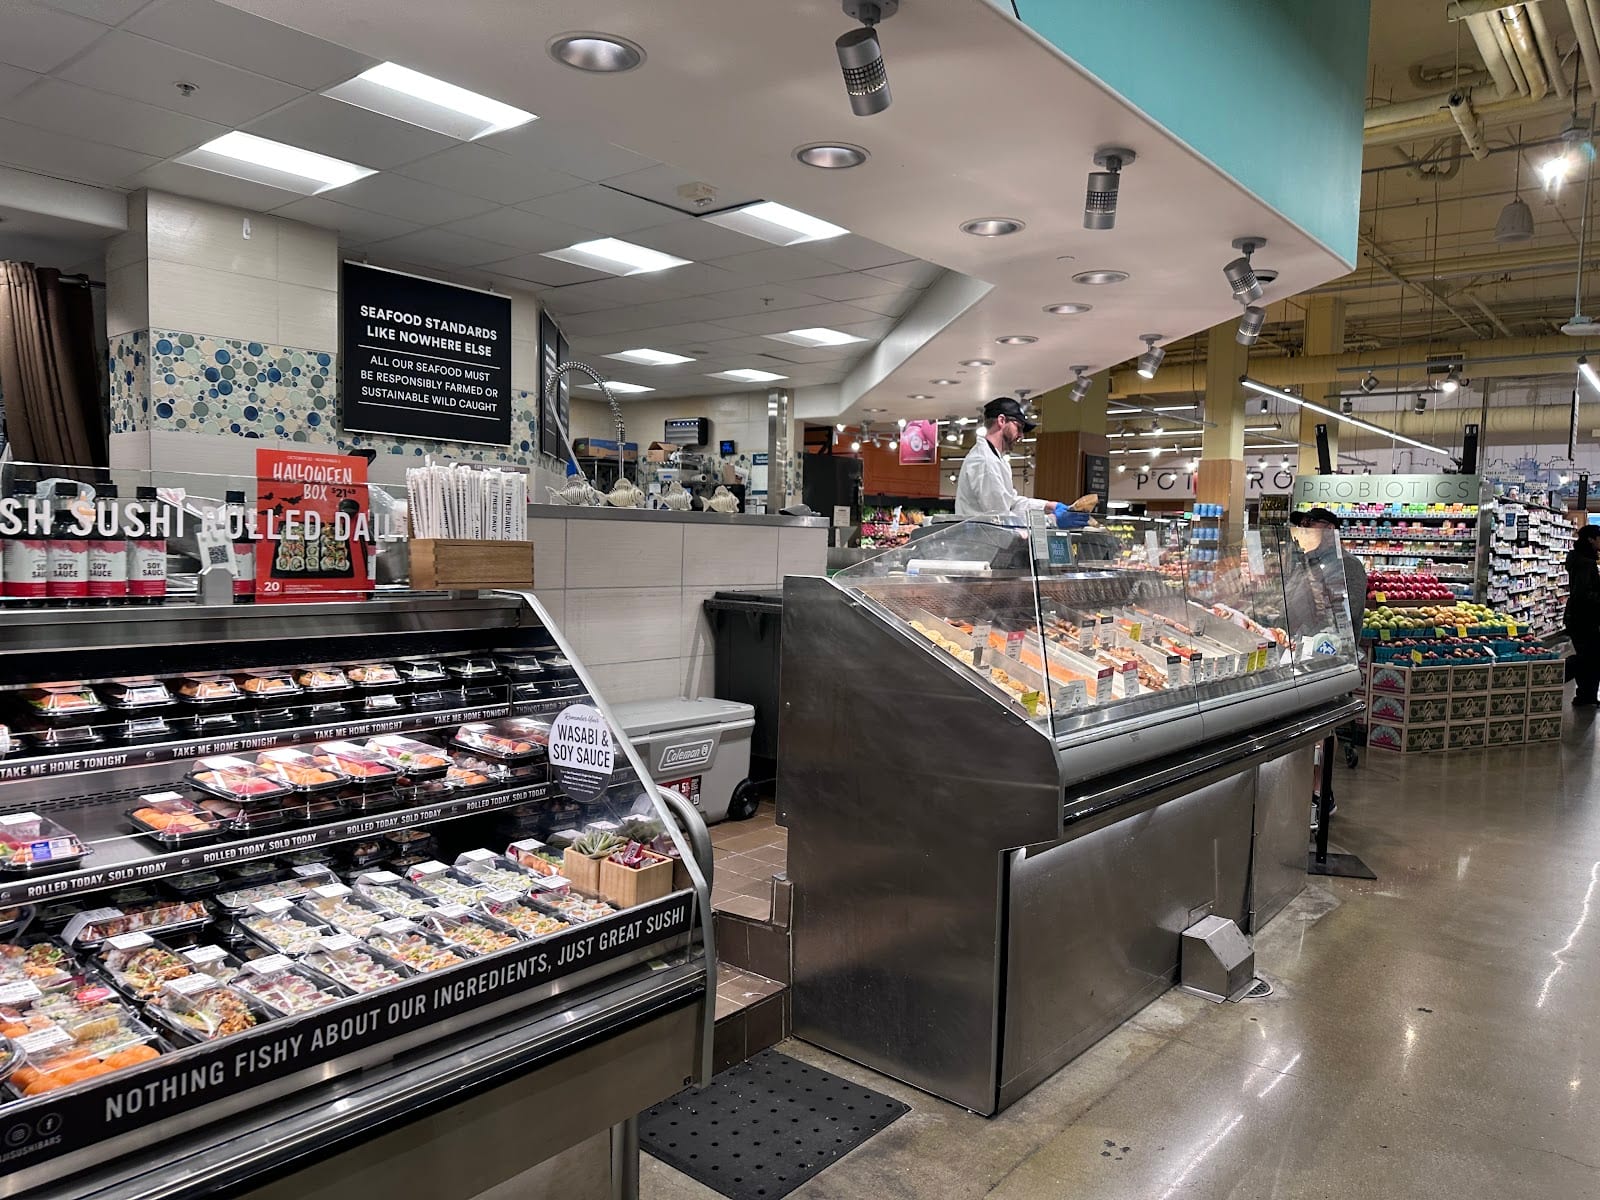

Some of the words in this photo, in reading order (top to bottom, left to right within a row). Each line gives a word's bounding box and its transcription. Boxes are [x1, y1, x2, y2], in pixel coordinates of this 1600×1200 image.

[360, 305, 422, 327] SEAFOOD
[425, 317, 498, 341] STANDARDS
[366, 325, 396, 341] LIKE
[399, 330, 462, 352] NOWHERE
[464, 343, 492, 357] ELSE
[370, 355, 390, 367] ALL
[391, 358, 414, 370] OUR
[416, 361, 462, 378] SEAFOOD
[464, 369, 490, 382] MUST
[360, 370, 374, 381] BE
[376, 371, 443, 390] RESPONSIBLY
[444, 382, 483, 396] FARMED
[484, 388, 499, 399] OR
[361, 386, 430, 404] SUSTAINABLE
[431, 396, 457, 408] WILD
[458, 399, 498, 413] CAUGHT
[273, 462, 352, 485] HALLOWEEN
[1137, 471, 1293, 490] POTRO
[304, 484, 328, 500] BOX
[1302, 481, 1470, 498] PROBIOTICS
[70, 501, 184, 538] SUSHI
[202, 506, 321, 541] ROLLED
[93, 562, 107, 570] SOY
[264, 581, 280, 592] 20
[434, 714, 450, 724] TAKE
[452, 713, 462, 722] ME
[463, 710, 481, 720] HOME
[483, 707, 510, 719] TONIGHT
[314, 729, 334, 739] TAKE
[335, 728, 347, 737] ME
[349, 724, 370, 735] HOME
[371, 721, 403, 733] TONIGHT
[557, 723, 598, 746] WASABI
[601, 730, 609, 747] &
[172, 746, 195, 757] TAKE
[198, 744, 212, 754] ME
[213, 741, 239, 752] HOME
[241, 736, 278, 749] TONIGHT
[553, 743, 574, 762] SOY
[576, 747, 610, 769] SAUCE
[667, 748, 700, 762] Coleman
[0, 766, 27, 779] TAKE
[30, 763, 46, 775] ME
[49, 759, 80, 773] HOME
[83, 754, 128, 768] TONIGHT
[466, 798, 490, 811] ROLLED
[512, 791, 528, 801] SOLD
[528, 787, 547, 798] TODAY
[346, 822, 374, 835] ROLLED
[401, 812, 419, 824] SOLD
[420, 808, 442, 820] TODAY
[203, 849, 236, 863] ROLLED
[269, 838, 290, 850] SOLD
[291, 833, 317, 845] TODAY
[27, 880, 68, 897] ROLLED
[108, 868, 134, 882] SOLD
[136, 862, 167, 876] TODAY
[105, 1060, 225, 1122] NOTHING
[235, 1034, 303, 1077] FISHY
[310, 1009, 382, 1052] ABOUT
[387, 994, 426, 1024] OUR
[433, 953, 552, 1009] INGREDIENTS,
[557, 936, 595, 966] JUST
[599, 920, 643, 950] GREAT
[646, 905, 685, 934] SUSHI
